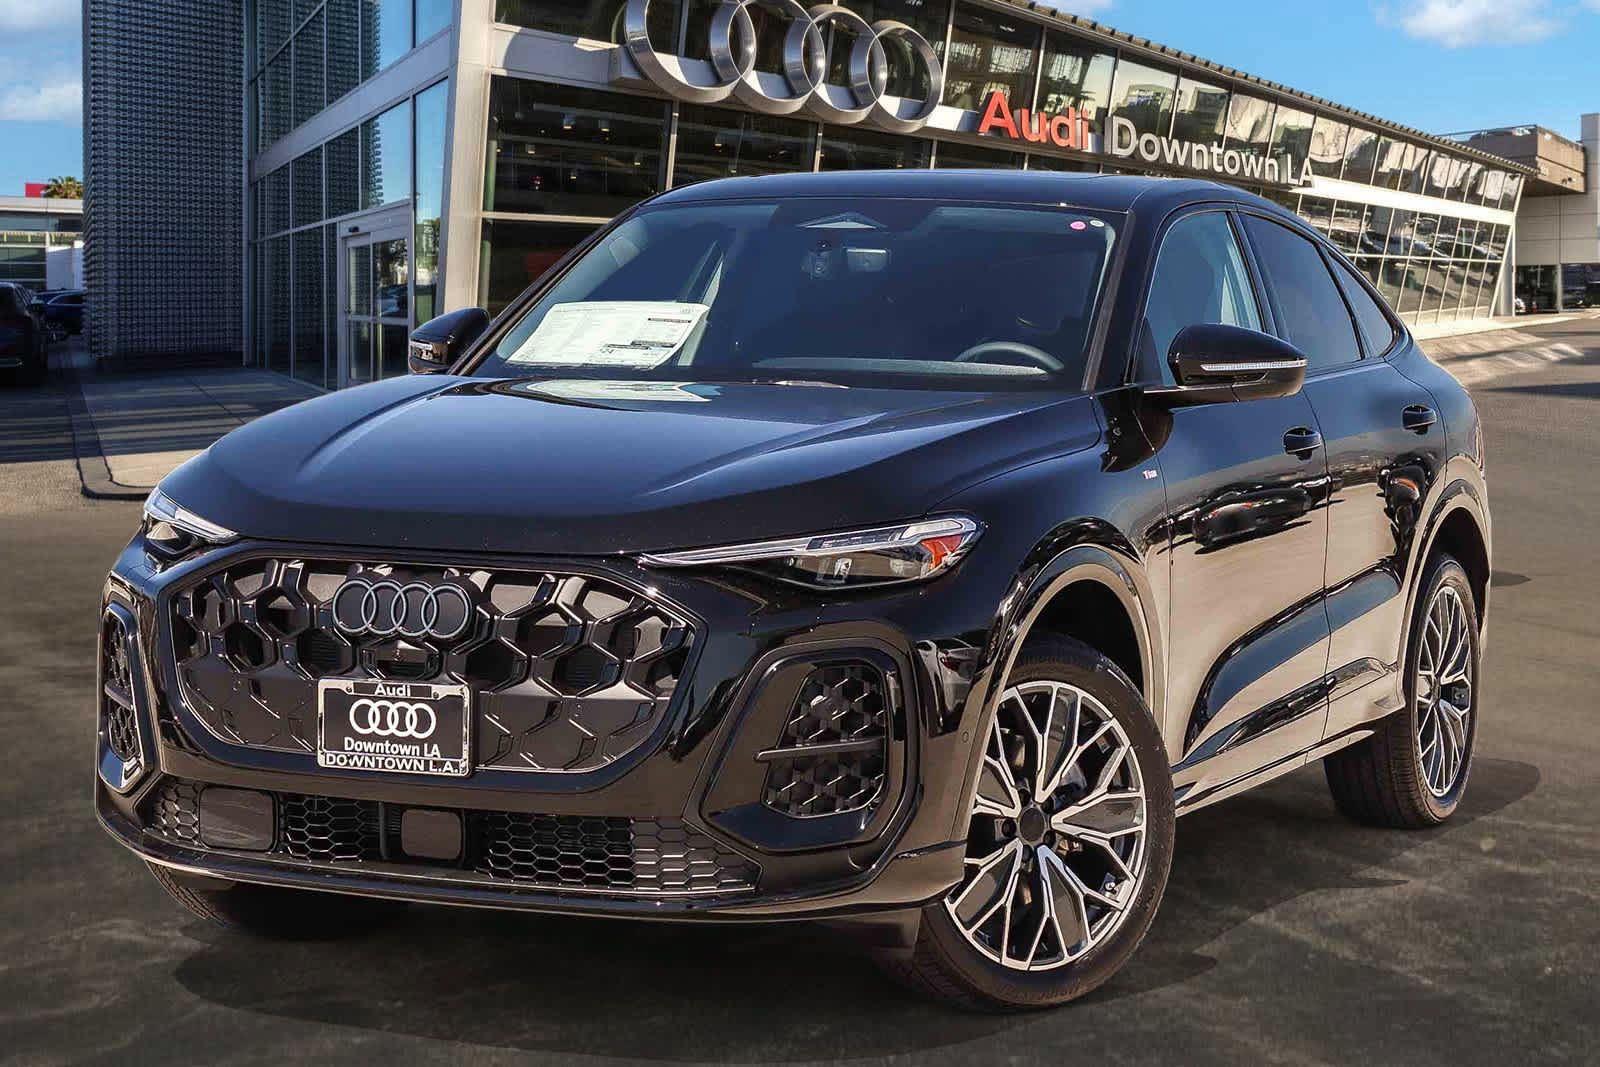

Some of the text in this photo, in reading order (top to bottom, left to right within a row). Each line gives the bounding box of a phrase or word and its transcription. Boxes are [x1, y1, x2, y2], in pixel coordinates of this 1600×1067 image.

[978, 91, 1315, 187] Audi Downtown LA
[375, 684, 411, 697] Audi
[344, 736, 441, 758] Downtown LA
[327, 753, 459, 774] DOWNTOWN L.A.
